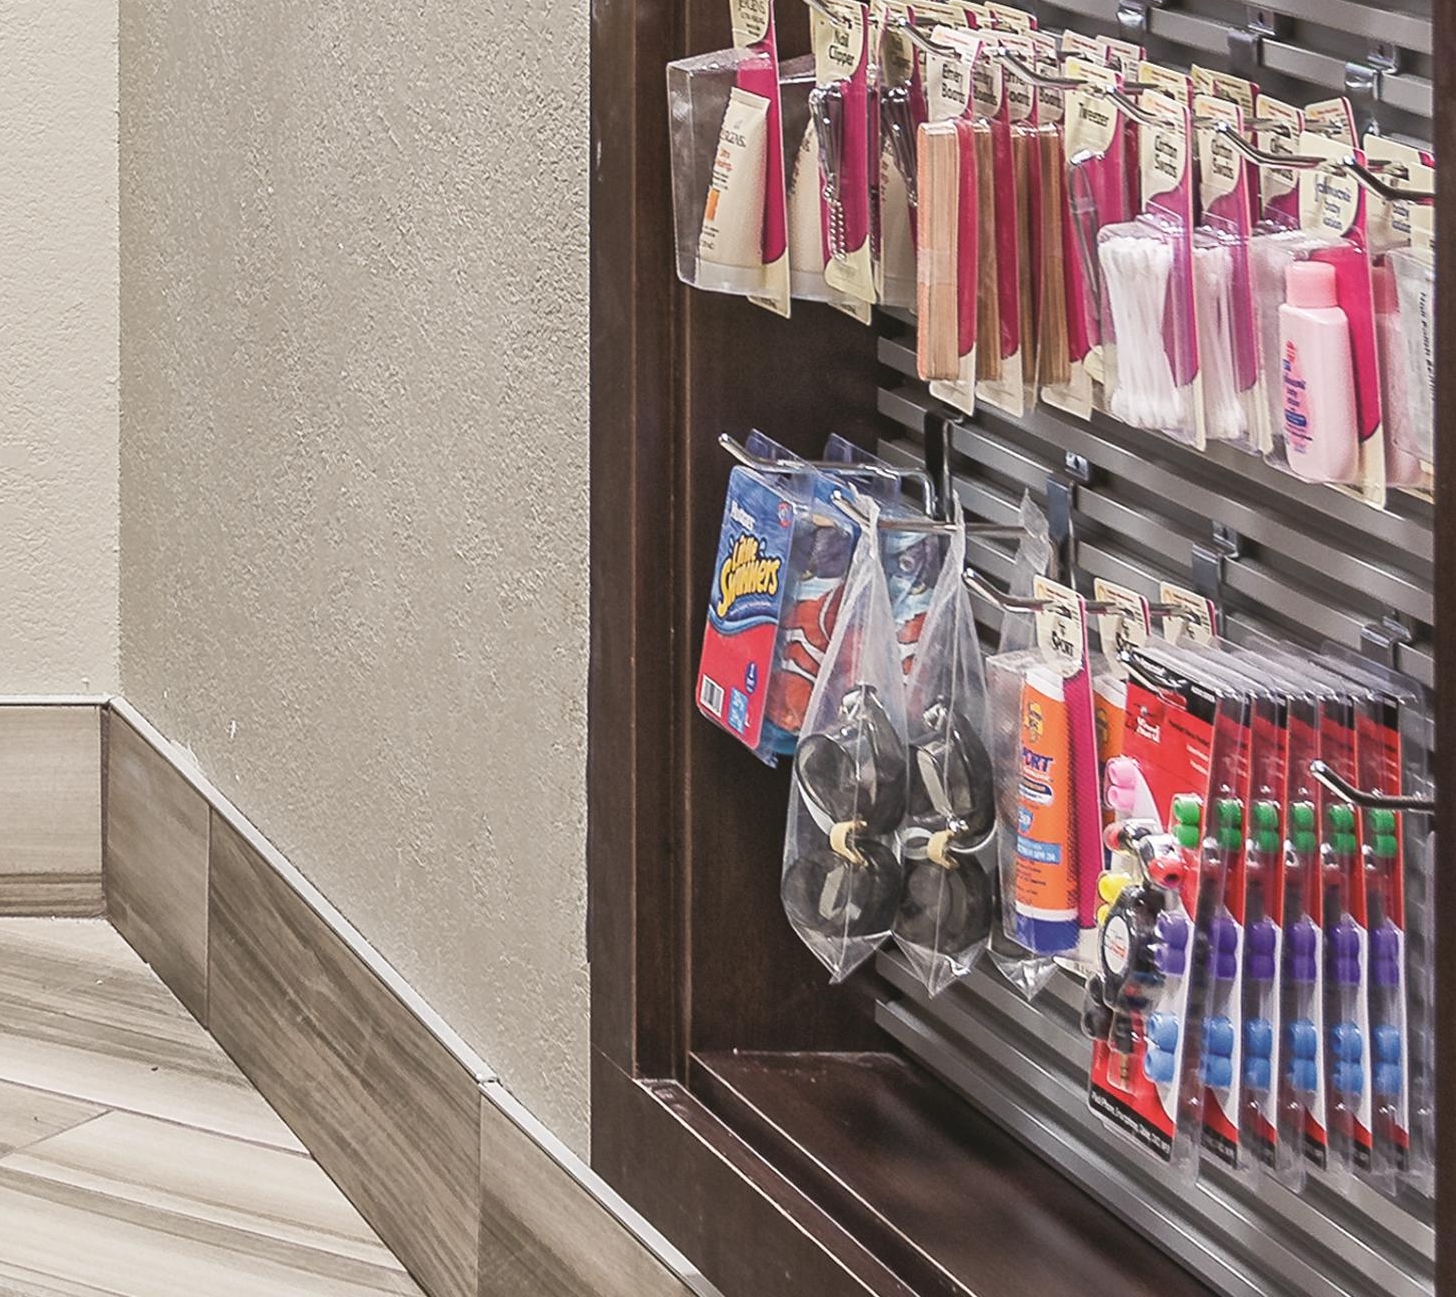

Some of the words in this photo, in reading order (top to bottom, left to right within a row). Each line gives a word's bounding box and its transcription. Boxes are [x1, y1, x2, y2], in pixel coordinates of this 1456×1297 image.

[832, 33, 849, 48] Nail
[829, 48, 855, 66] Clipper
[941, 64, 962, 80] Emery
[941, 84, 966, 101] Boards
[1078, 110, 1110, 128] Tweezer
[1154, 136, 1178, 159] Cotton
[1154, 157, 1178, 180] Swabs
